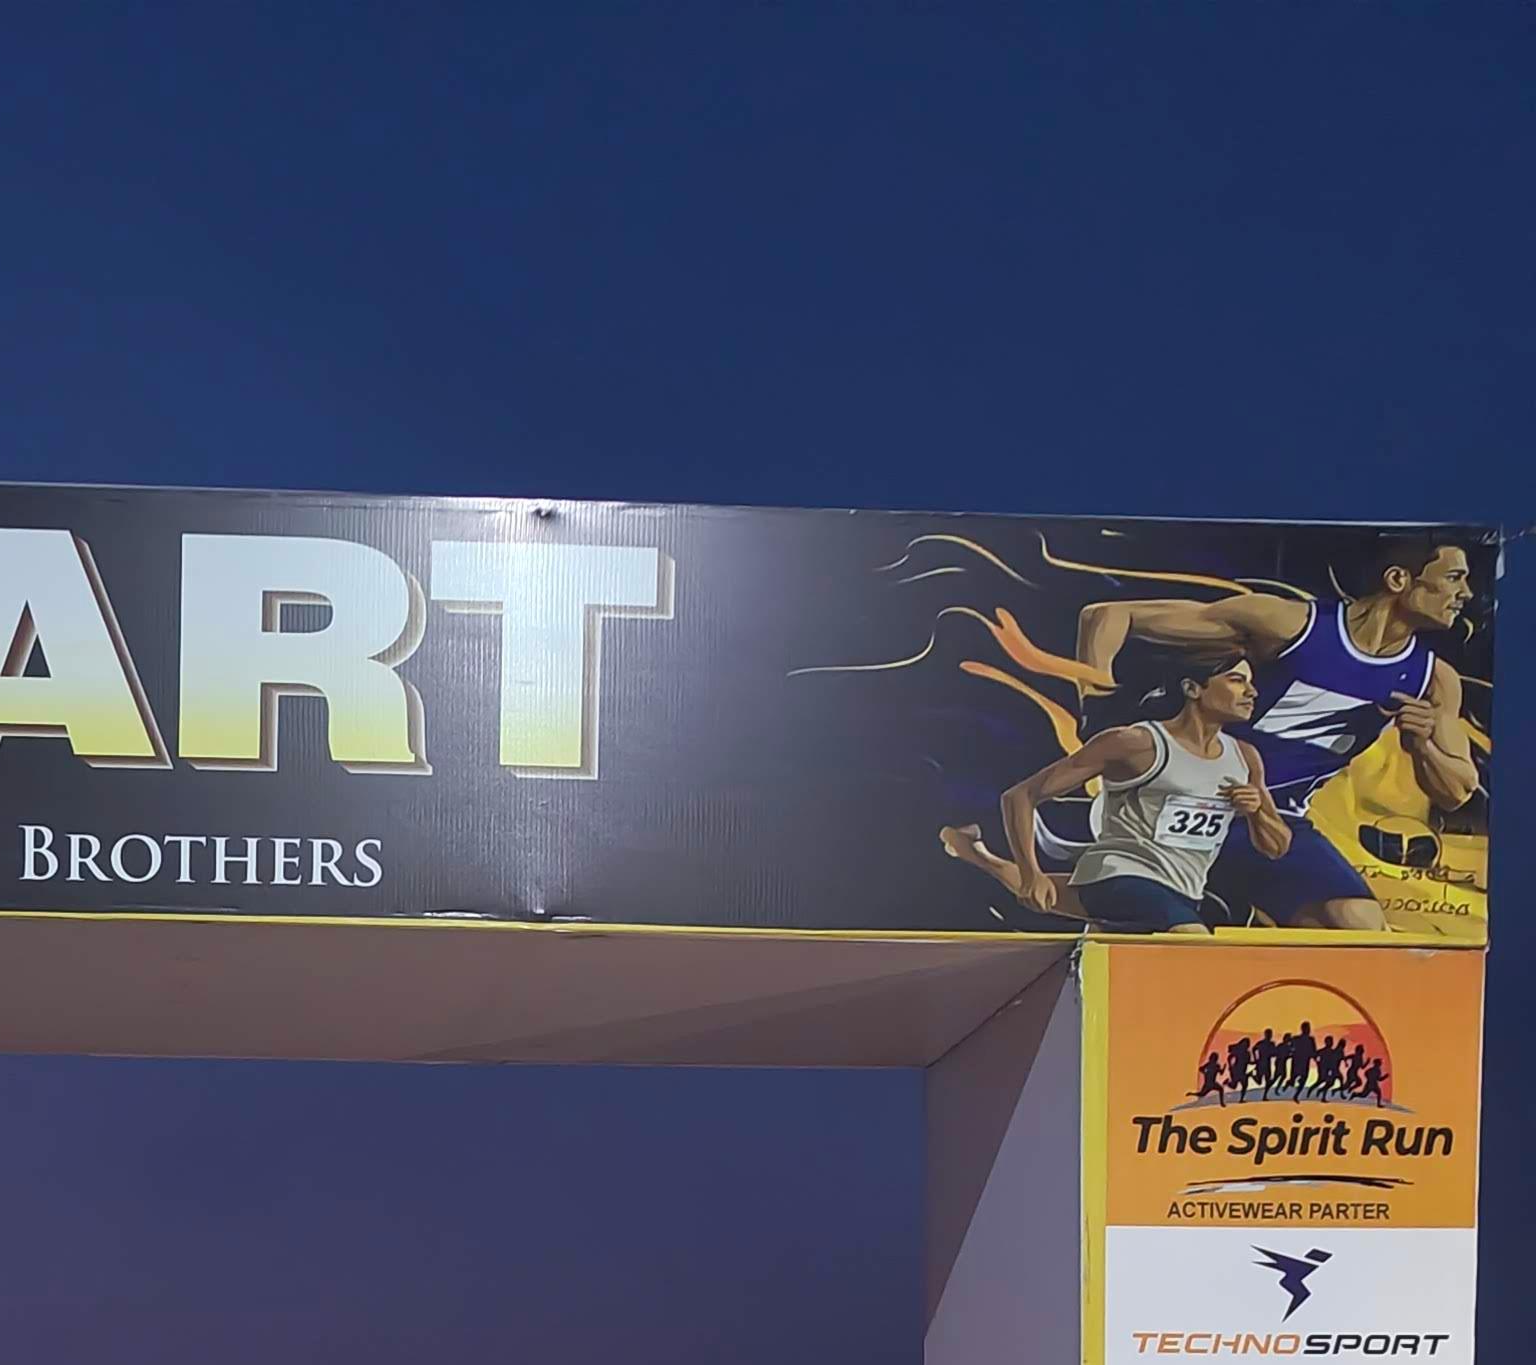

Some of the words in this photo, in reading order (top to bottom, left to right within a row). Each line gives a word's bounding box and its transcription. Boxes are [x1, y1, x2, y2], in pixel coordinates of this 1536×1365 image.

[1167, 808, 1225, 838] 325
[18, 826, 383, 889] BROTHERS
[1132, 1114, 1217, 1154] The
[1227, 1113, 1350, 1165] Spirit
[1360, 1118, 1453, 1156] Run
[1167, 1201, 1302, 1219] ACTIVEWEAR
[1308, 1202, 1390, 1220] PARTER
[1132, 1332, 1449, 1356] TECHNOSPORT
